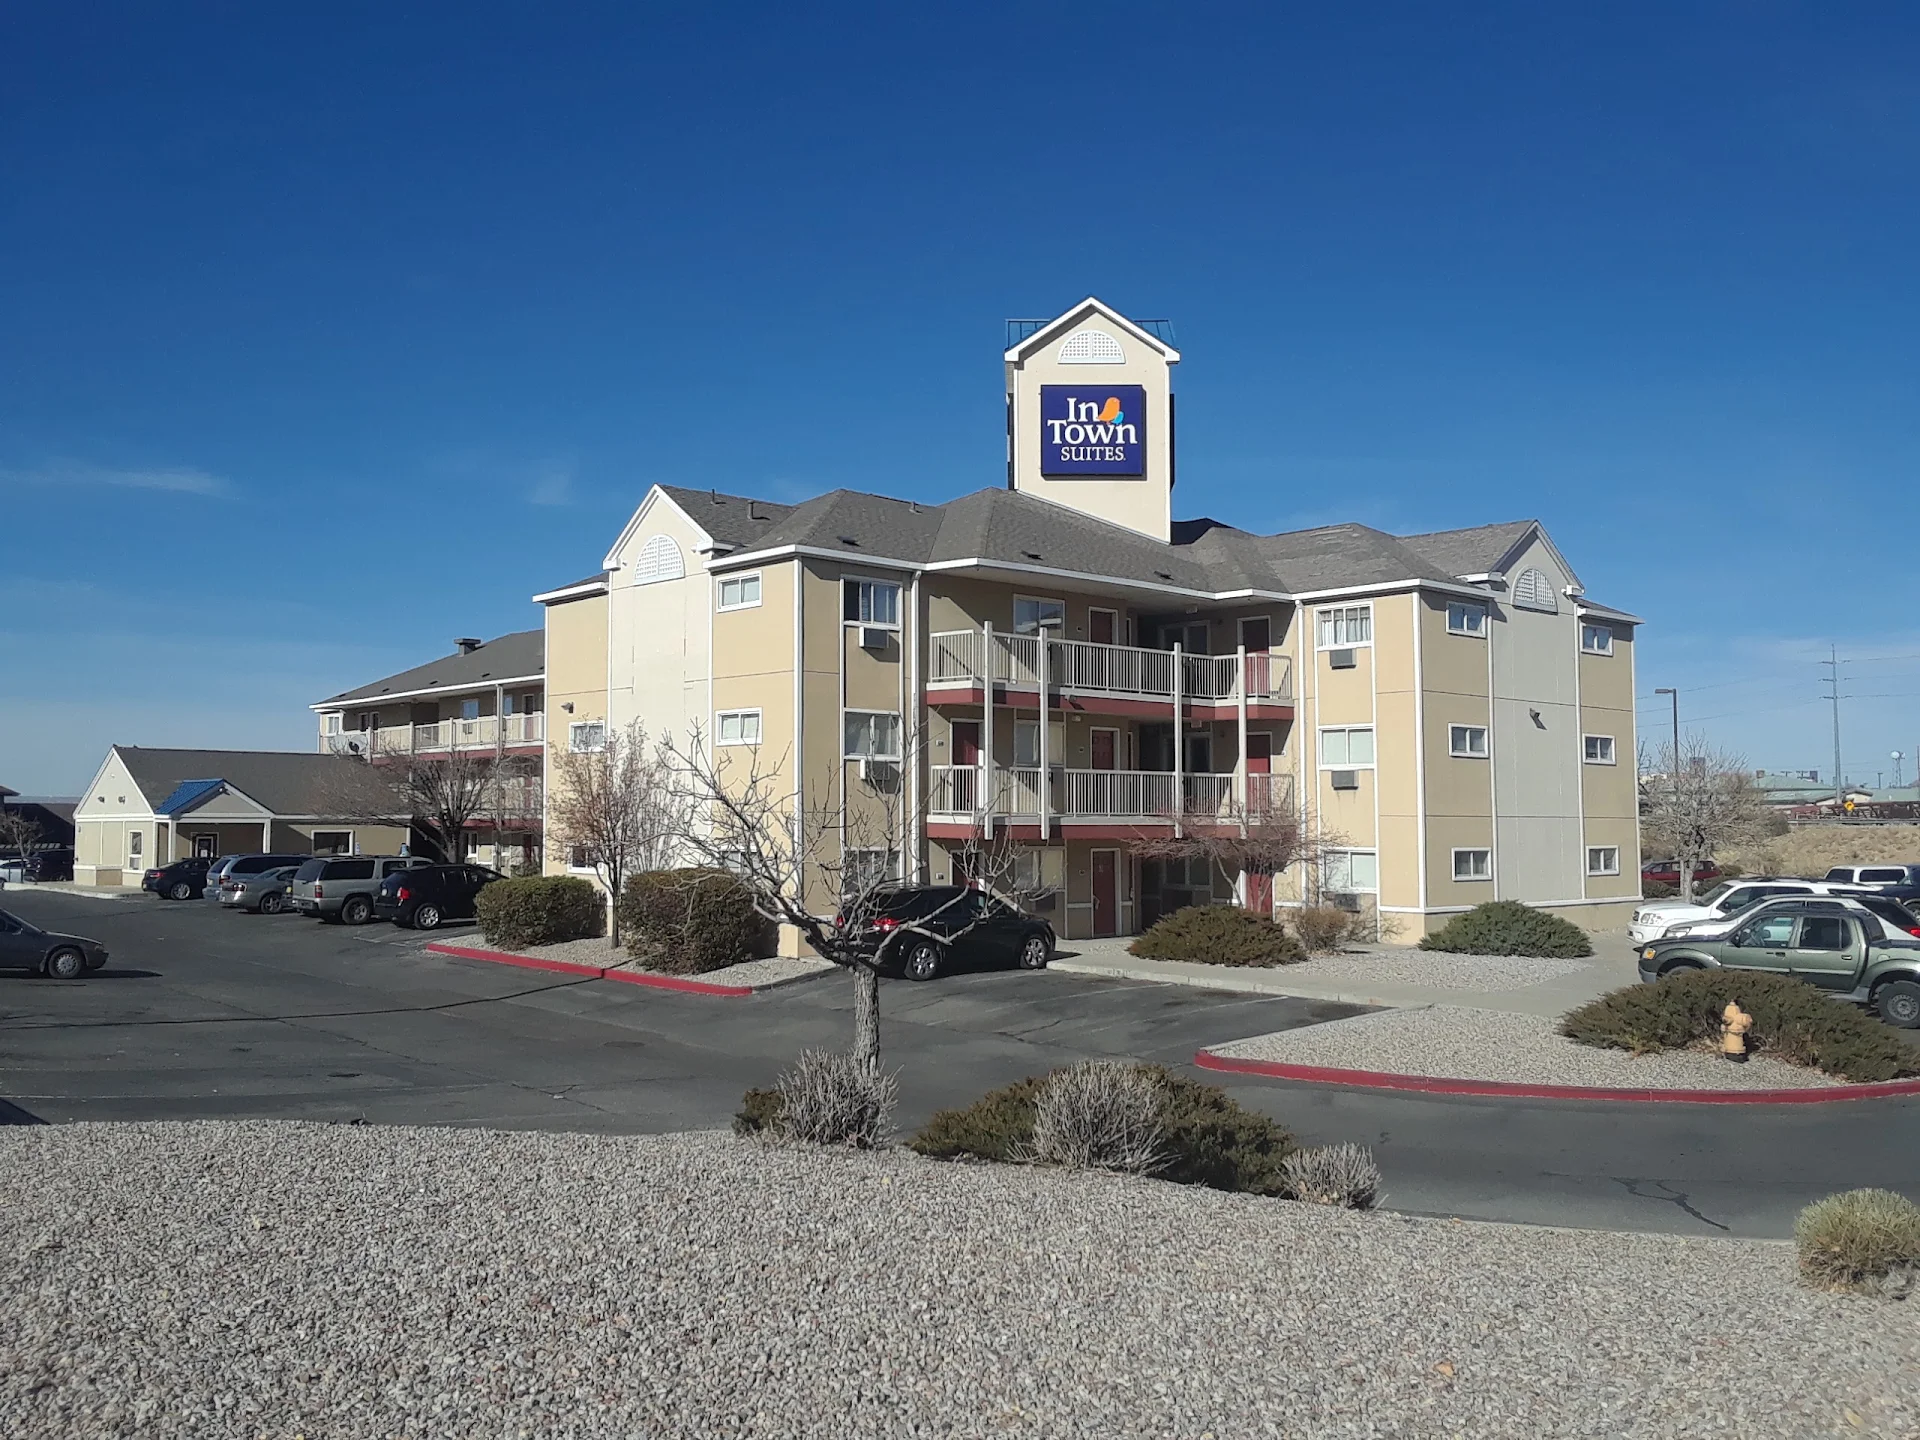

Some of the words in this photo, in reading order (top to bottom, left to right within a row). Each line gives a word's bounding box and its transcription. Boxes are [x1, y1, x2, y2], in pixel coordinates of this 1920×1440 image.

[1067, 398, 1100, 422] In
[1047, 419, 1138, 444] Town
[1060, 446, 1125, 461] SUITES
